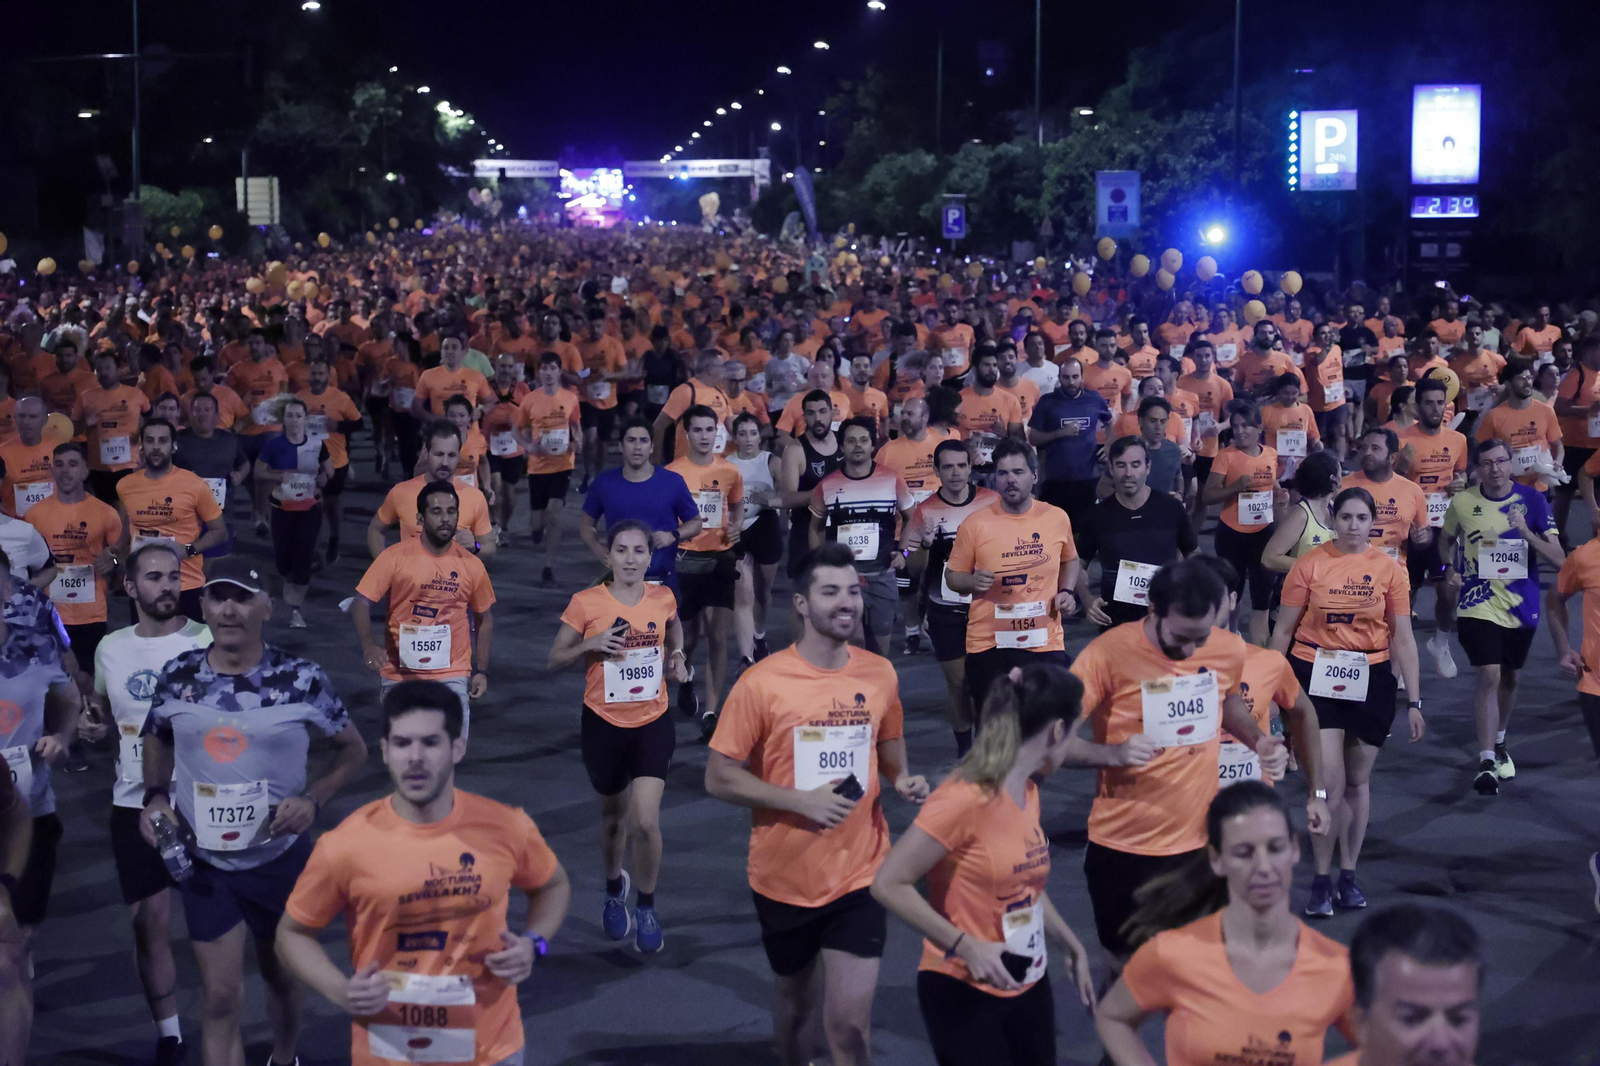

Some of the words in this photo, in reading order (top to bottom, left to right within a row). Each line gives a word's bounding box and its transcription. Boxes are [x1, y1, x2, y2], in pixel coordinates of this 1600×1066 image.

[1314, 117, 1347, 163] P
[947, 209, 960, 224] P
[1248, 502, 1268, 512] 10239
[1425, 503, 1447, 513] 12539
[848, 535, 869, 546] 8238
[1014, 543, 1044, 551] NOCTURNA
[1001, 551, 1028, 559] SEVILLA
[1029, 548, 1043, 557] KH7
[1489, 552, 1519, 563] 12048
[59, 577, 86, 588] 16261
[431, 579, 460, 588] NOCTURNA
[420, 584, 443, 593] SEVILLA
[443, 586, 458, 594] KH7
[1329, 588, 1357, 596] SEVILLA
[1357, 590, 1373, 598] KH7
[1010, 618, 1036, 631] 1154
[411, 640, 442, 652] 15587
[619, 665, 654, 681] 19898
[1325, 665, 1360, 681] 20649
[828, 710, 870, 718] NOCTURNA
[1167, 698, 1204, 718] 3048
[808, 719, 847, 727] SEVILLA
[848, 717, 870, 726] KH7
[819, 750, 854, 768] 8081
[1218, 762, 1252, 779] 2570
[208, 805, 255, 823] 17372
[425, 874, 482, 889] NOCTURNA
[398, 888, 450, 905] SEVILLA
[453, 884, 482, 897] KH7
[399, 1006, 448, 1028] 1088
